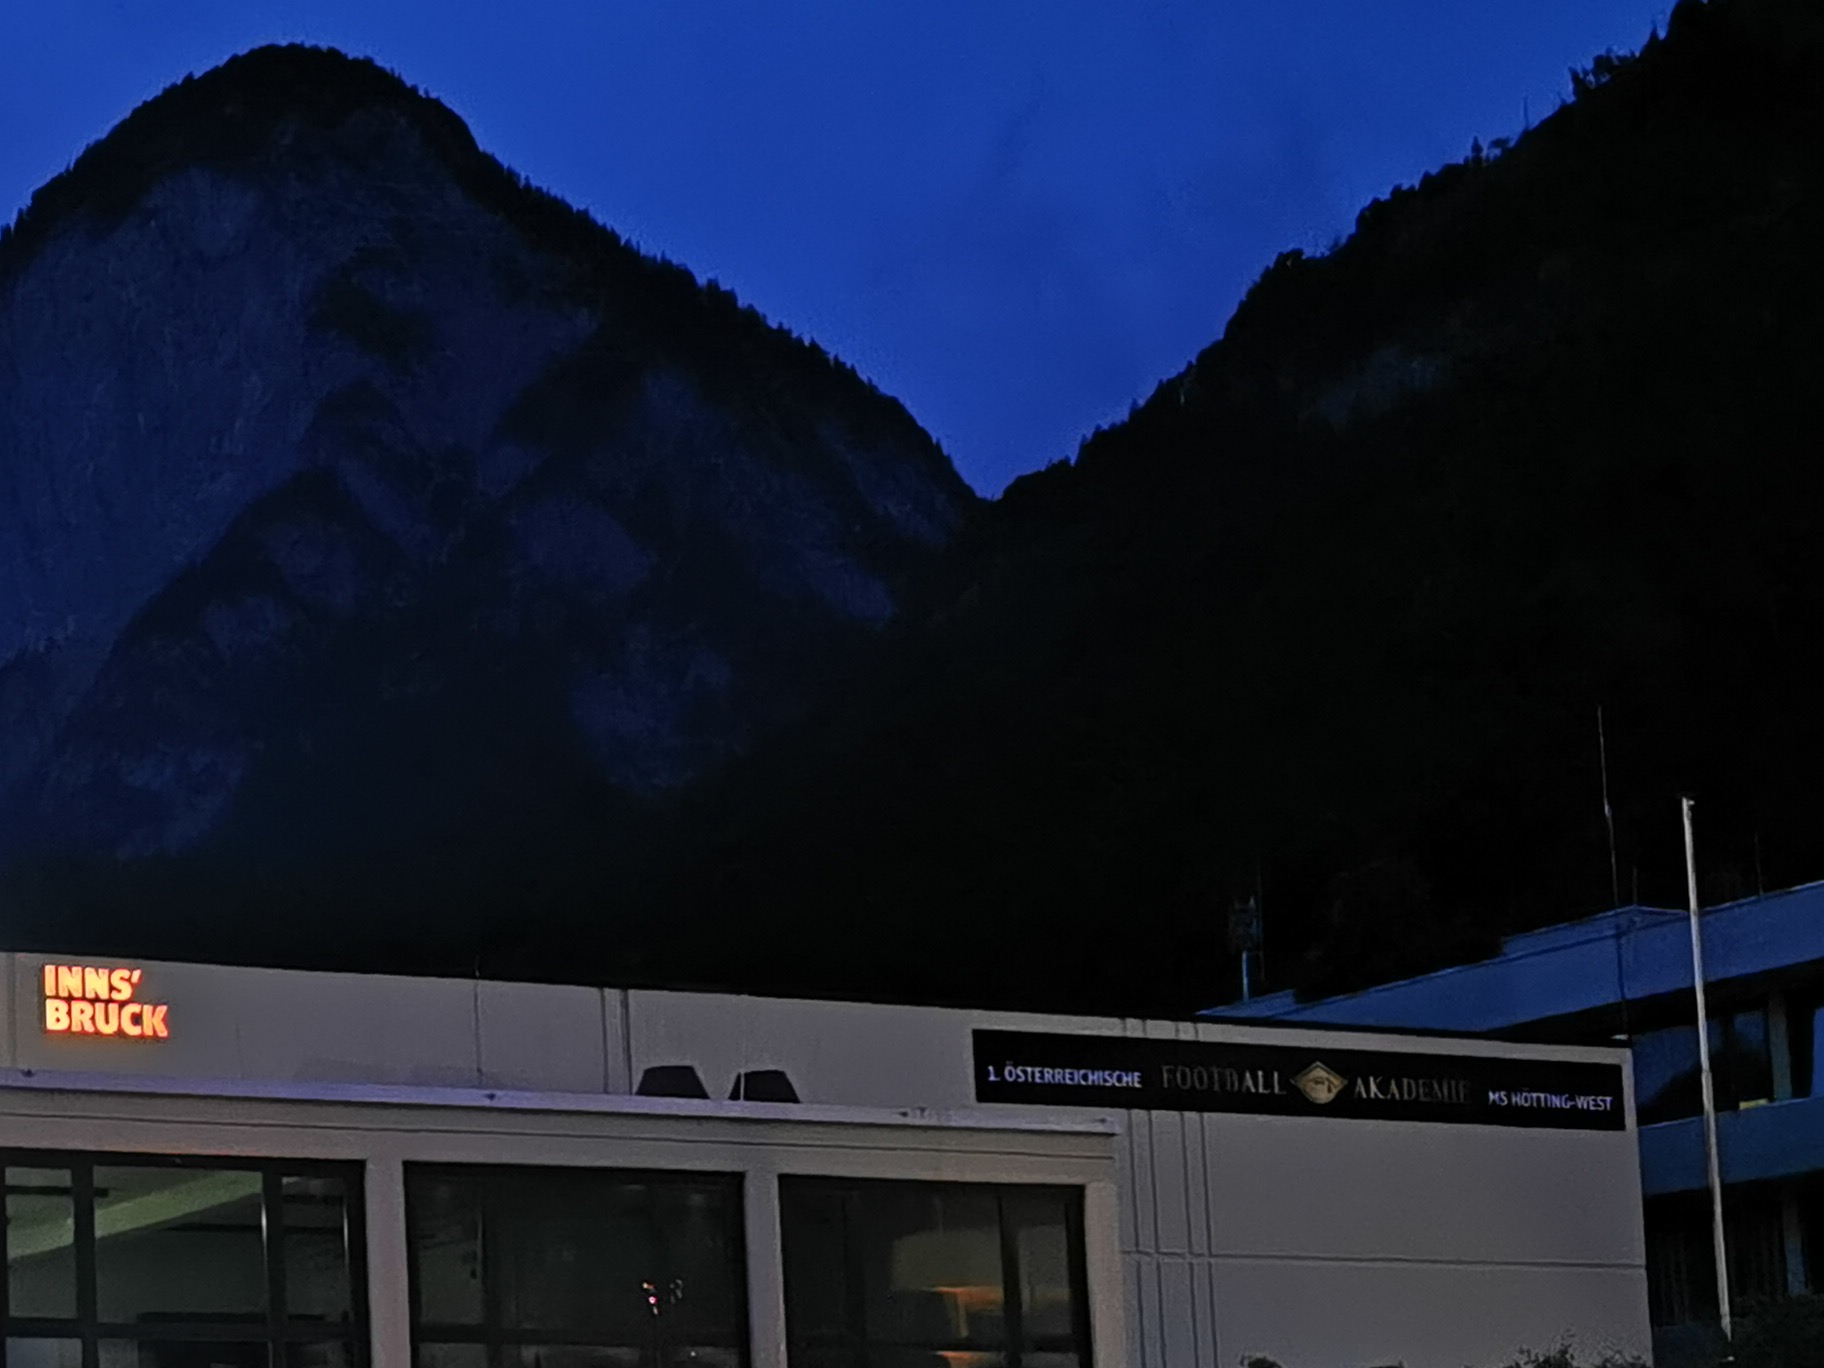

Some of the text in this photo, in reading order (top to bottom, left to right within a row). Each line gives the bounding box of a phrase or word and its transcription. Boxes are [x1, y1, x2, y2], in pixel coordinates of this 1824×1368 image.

[44, 964, 142, 1001] INNS'
[45, 998, 169, 1037] BRUCK
[1004, 1060, 1144, 1088] ÖSTERREICHISCHE
[1160, 1064, 1287, 1096] FOOTBALL
[1512, 1087, 1614, 1112] HÖTTING-WEST
